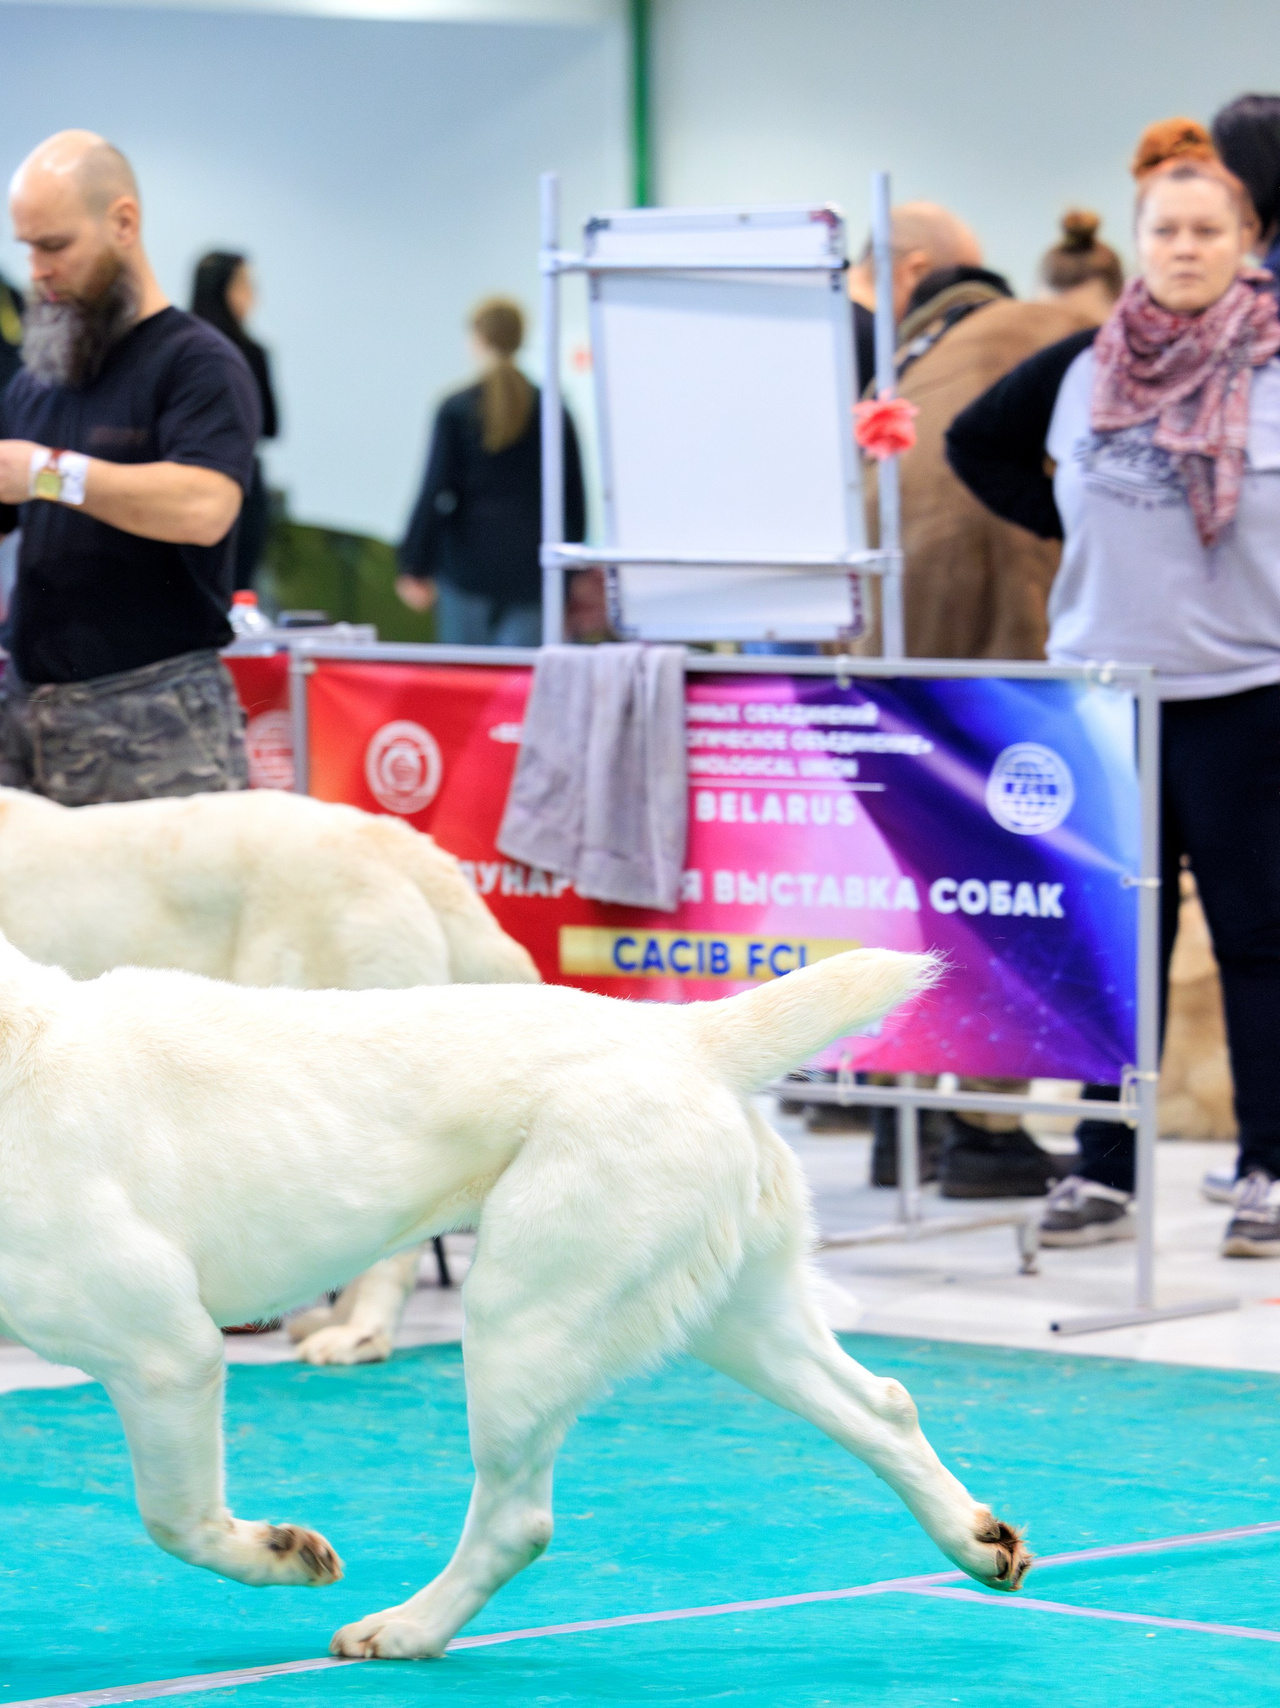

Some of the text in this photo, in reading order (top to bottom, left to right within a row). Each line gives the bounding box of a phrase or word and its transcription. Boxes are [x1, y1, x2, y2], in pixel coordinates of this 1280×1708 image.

[696, 791, 856, 825] BELARUS
[713, 869, 919, 912] ВЫСТАВКА
[929, 877, 1065, 919] СОБАК
[612, 936, 807, 978] CACIB FCI
